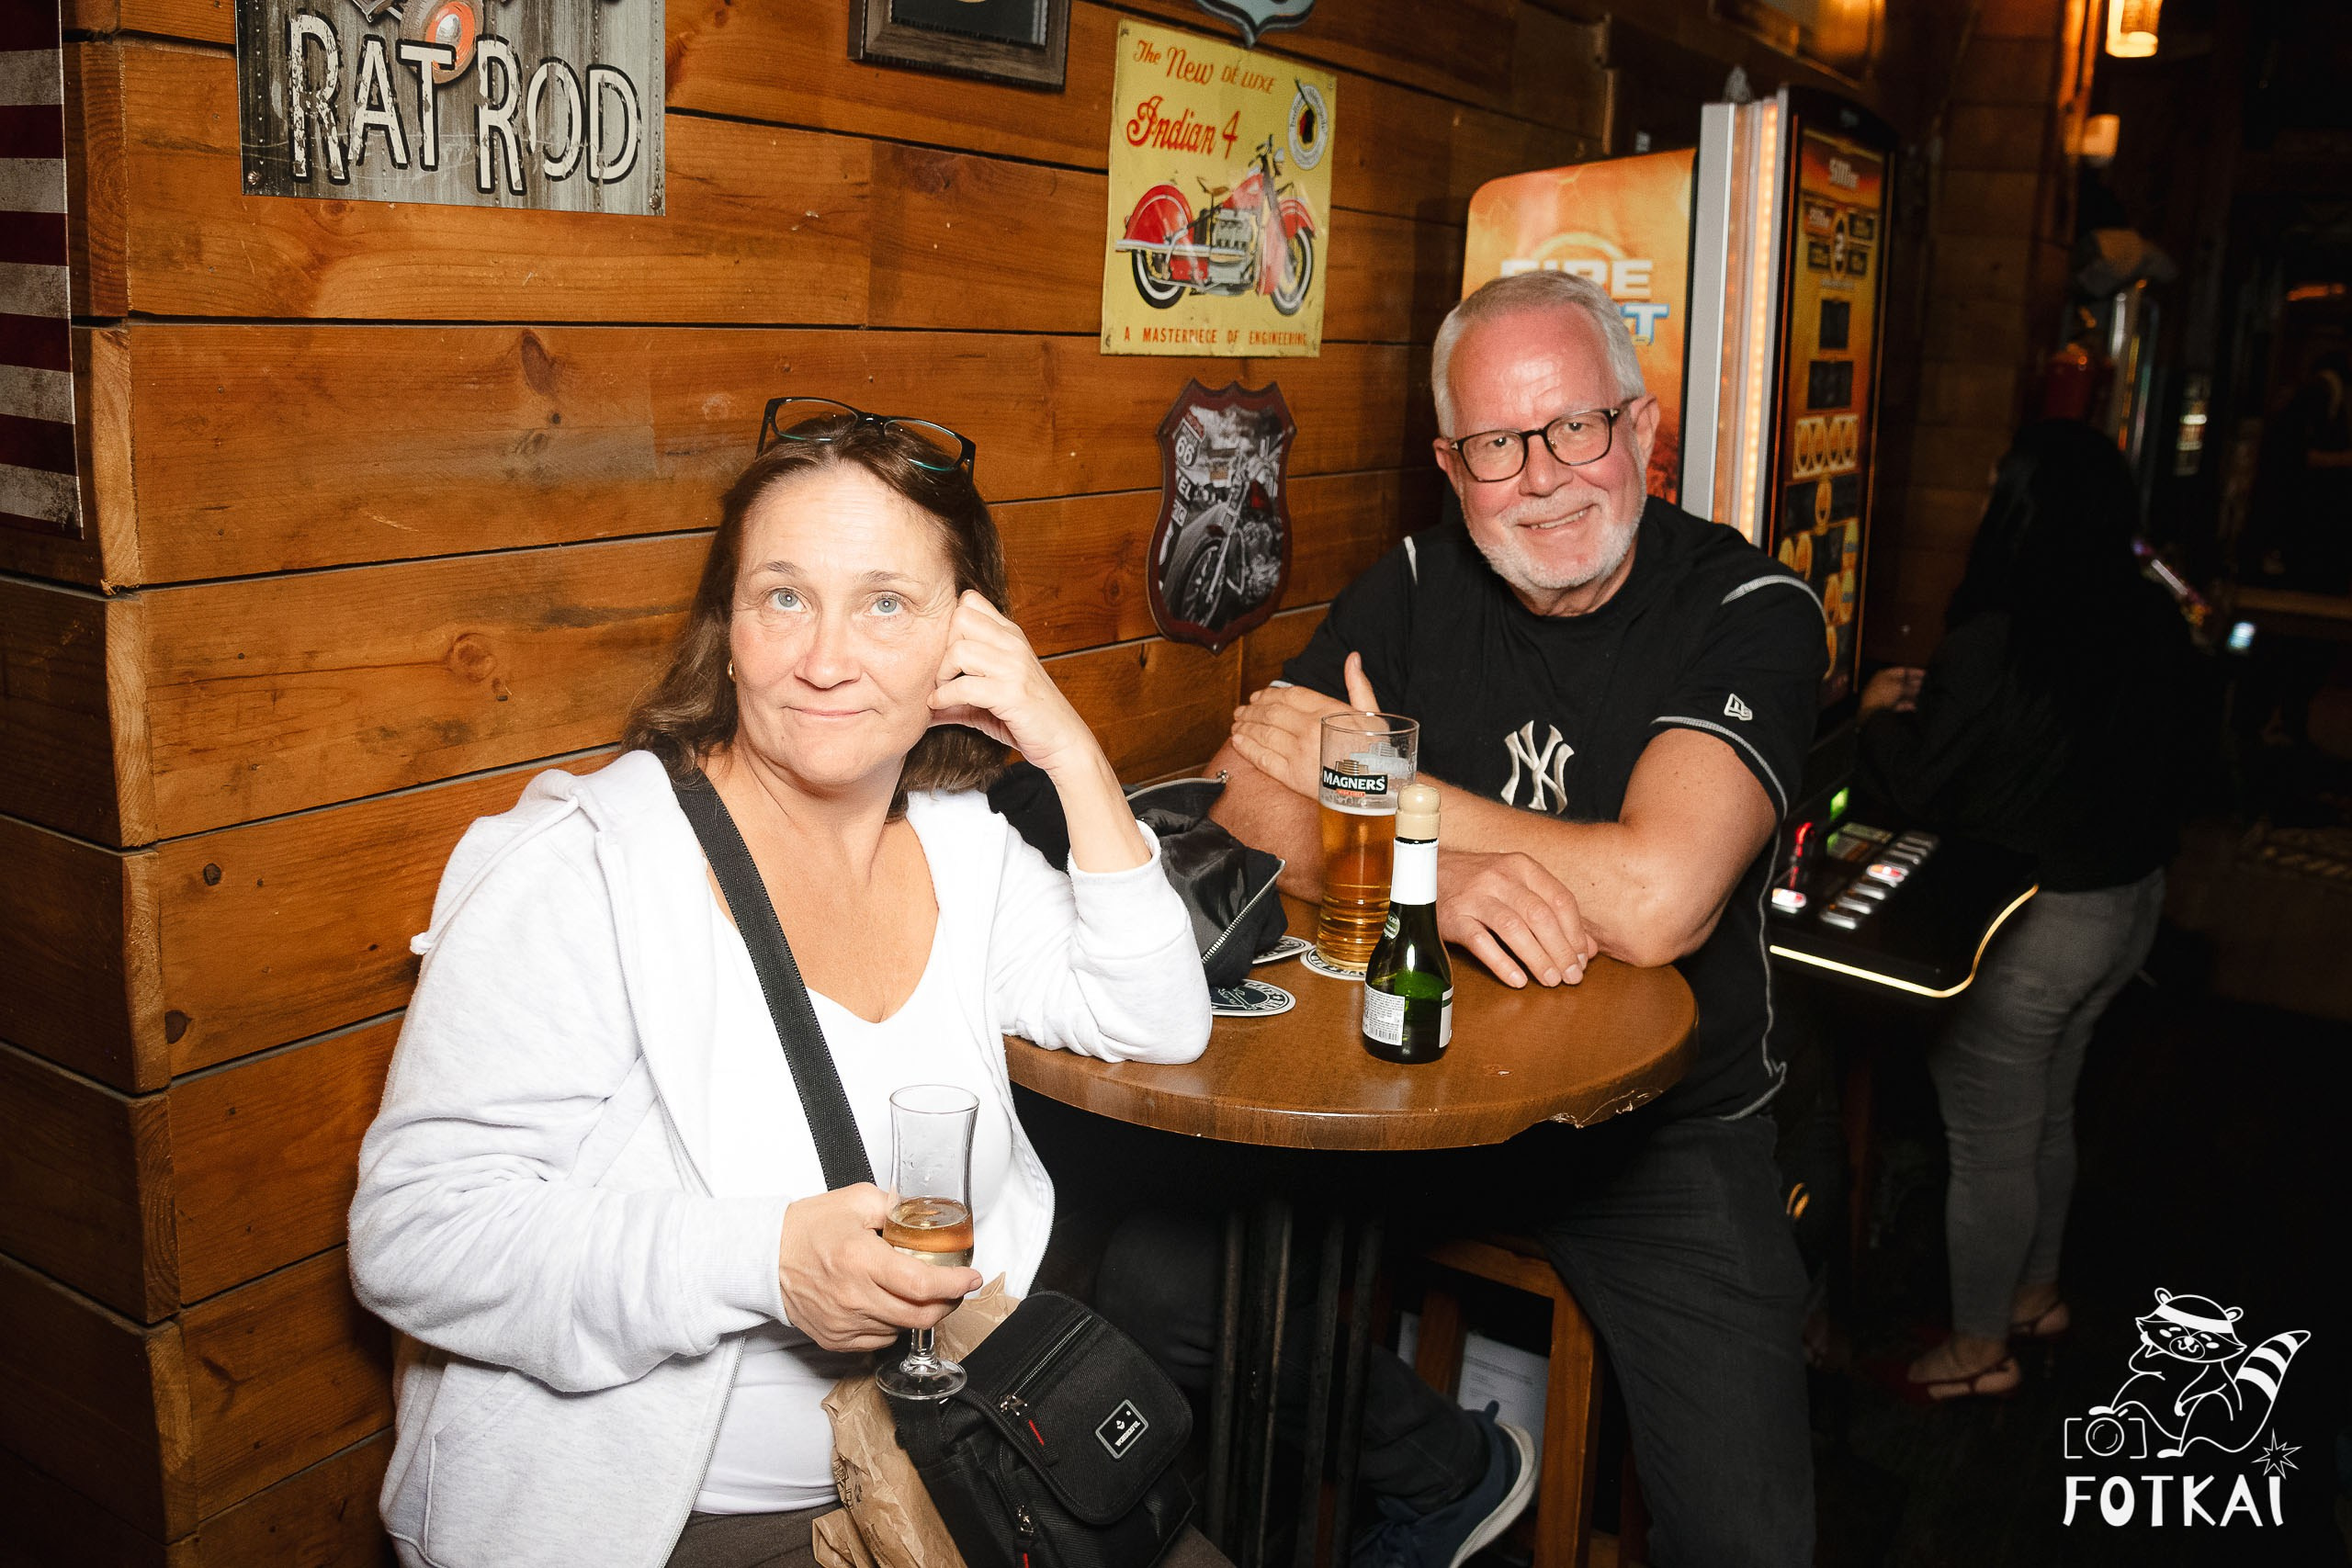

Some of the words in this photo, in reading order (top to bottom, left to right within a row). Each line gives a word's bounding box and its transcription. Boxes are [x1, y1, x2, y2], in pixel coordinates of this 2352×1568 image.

[1133, 39, 1161, 64] The
[1166, 47, 1214, 85] New
[288, 10, 457, 183] RAT
[475, 34, 641, 195] ROD
[1126, 96, 1216, 155] Indian
[1222, 110, 1240, 160] 4
[1124, 326, 1131, 343] A
[1142, 327, 1217, 344] MASTERPIECE
[1227, 330, 1239, 344] OF
[1249, 331, 1308, 346] ENGINEERING
[1176, 436, 1194, 467] 66
[1323, 770, 1385, 792] MAGNERS
[1500, 719, 1575, 815] NY
